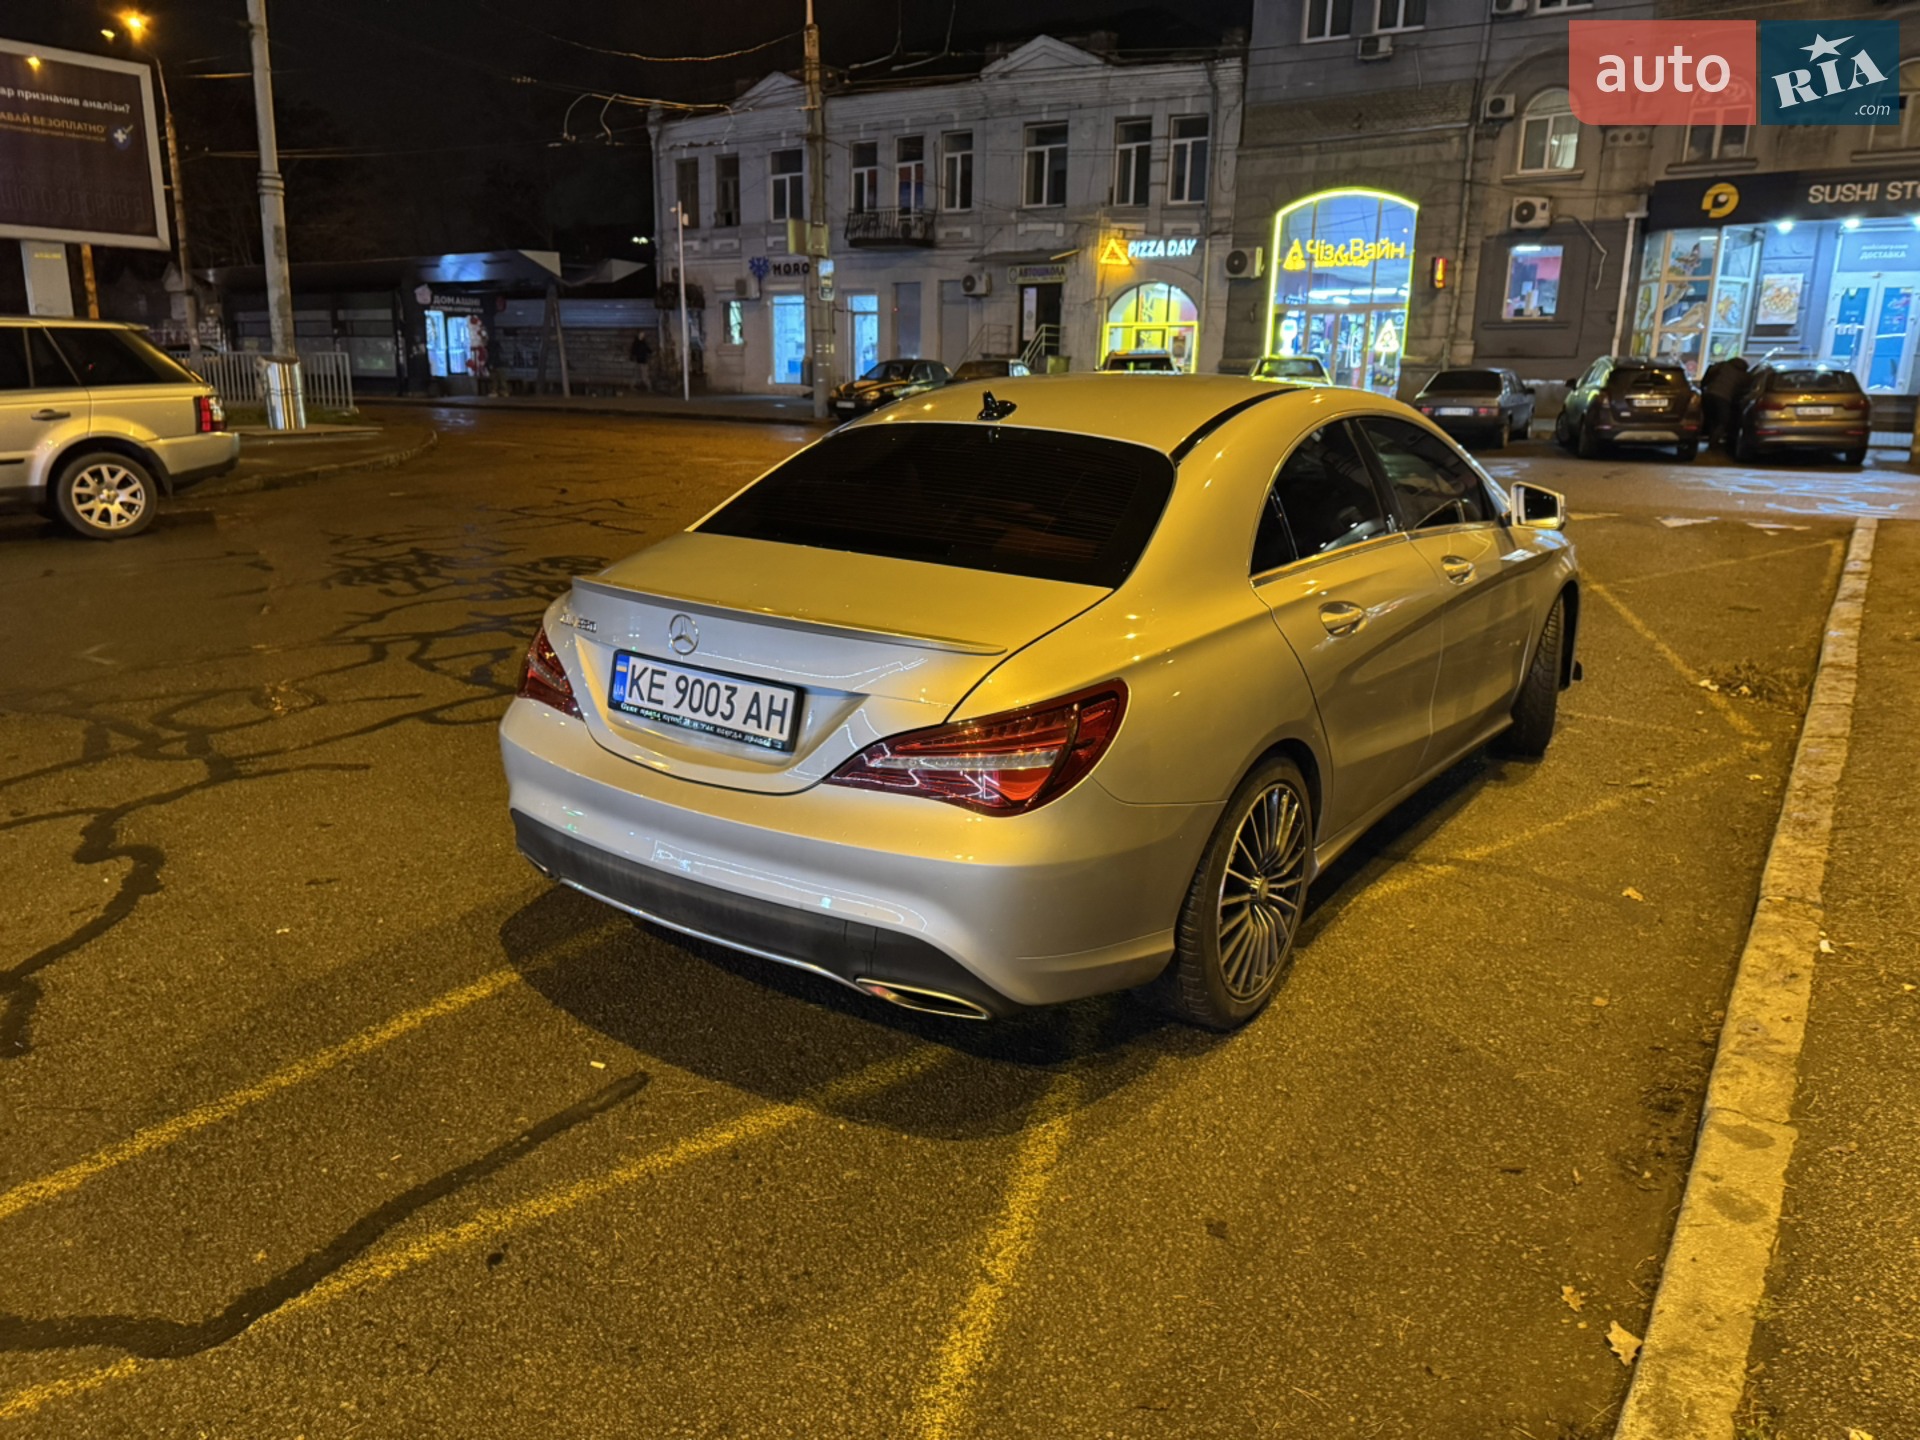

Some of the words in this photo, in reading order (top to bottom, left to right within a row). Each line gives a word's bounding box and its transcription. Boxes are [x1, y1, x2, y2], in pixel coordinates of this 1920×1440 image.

[17, 88, 80, 108] призначив
[82, 101, 131, 114] аналізи?
[1808, 183, 1880, 204] SUSHI
[1886, 181, 1920, 201] ST
[1128, 240, 1166, 259] PIZZA
[1166, 238, 1198, 256] DAY
[628, 664, 667, 705] KE
[674, 674, 738, 721] 9003
[742, 691, 788, 735] AH
